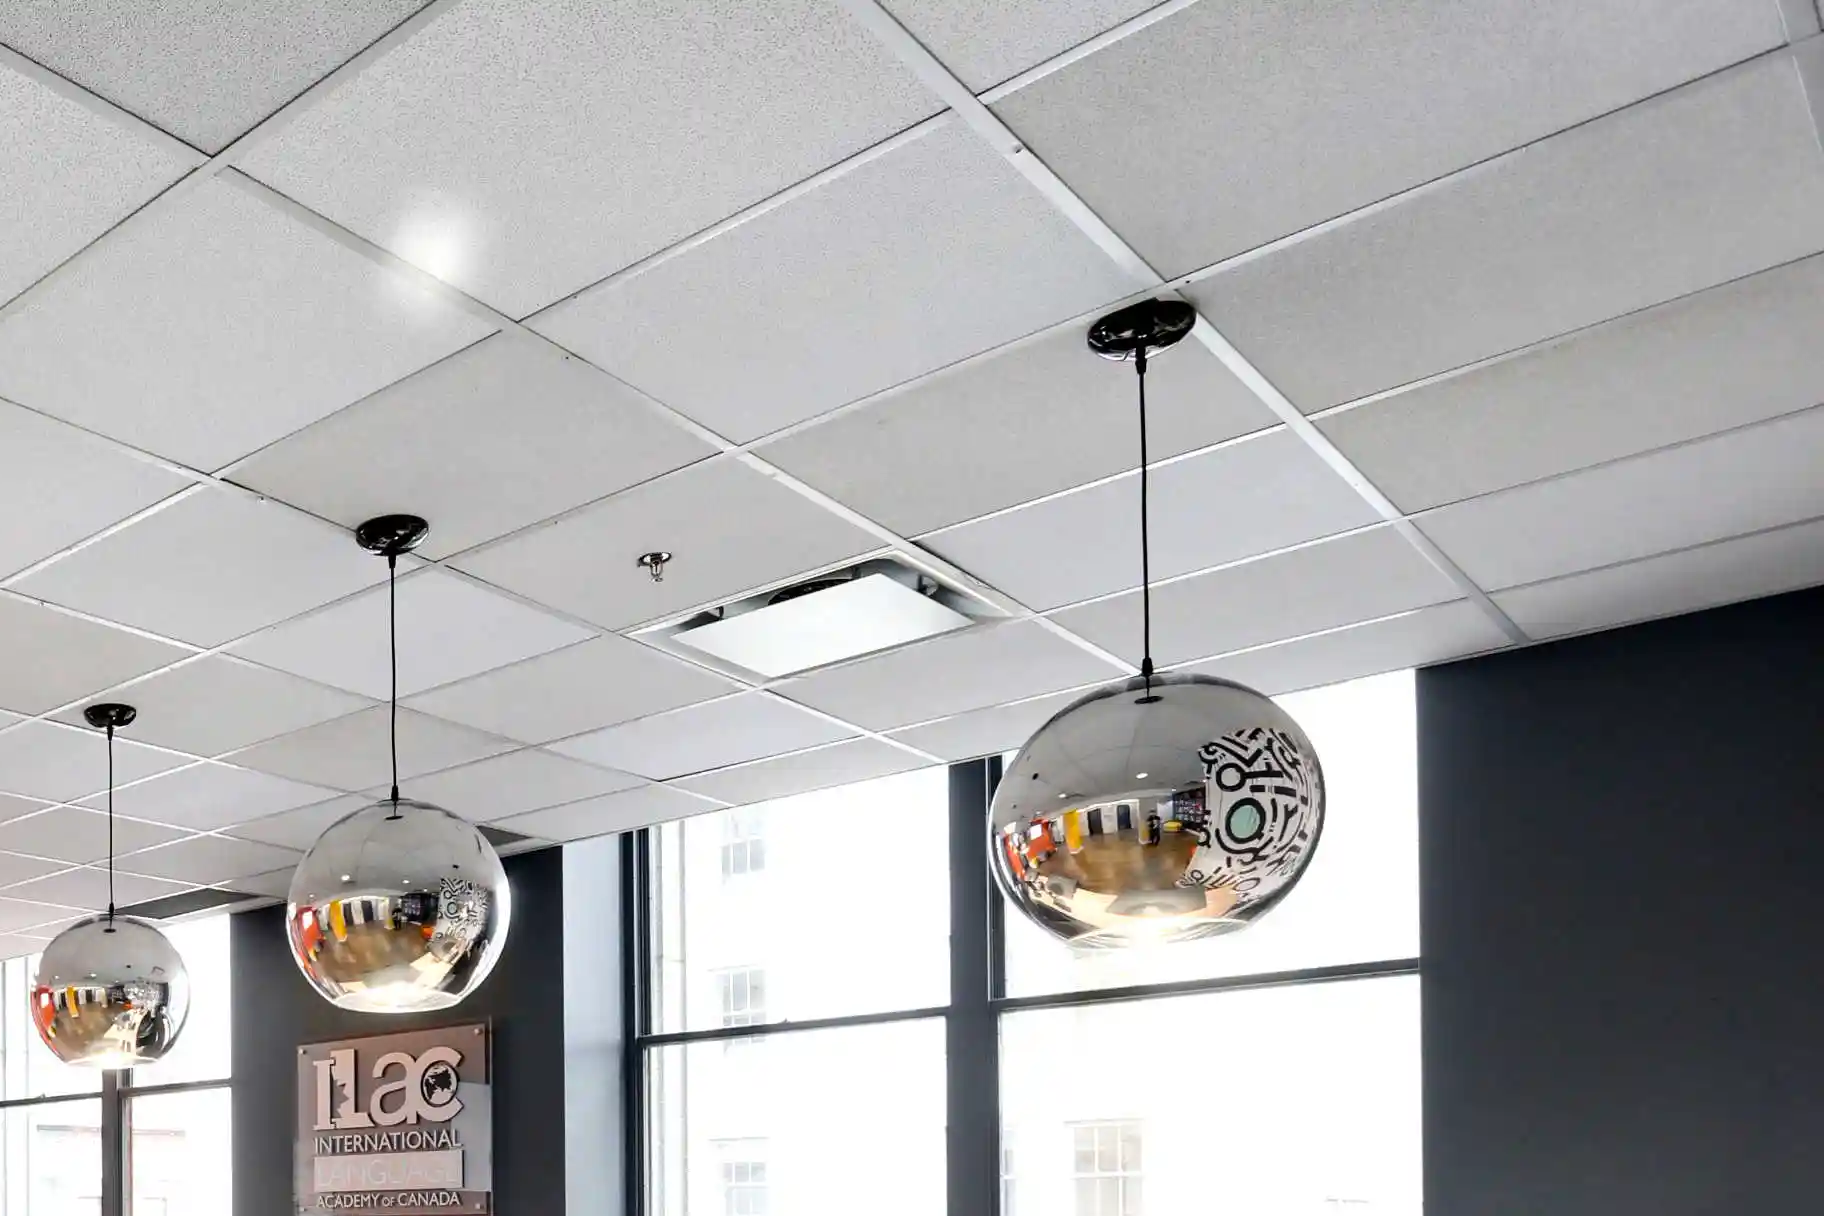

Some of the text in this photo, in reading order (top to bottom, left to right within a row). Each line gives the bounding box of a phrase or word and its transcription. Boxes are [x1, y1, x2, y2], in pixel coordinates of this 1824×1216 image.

[313, 1129, 463, 1154] INTERNATIONAL
[316, 1193, 381, 1209] ACADEMY
[397, 1192, 461, 1207] CANADA
